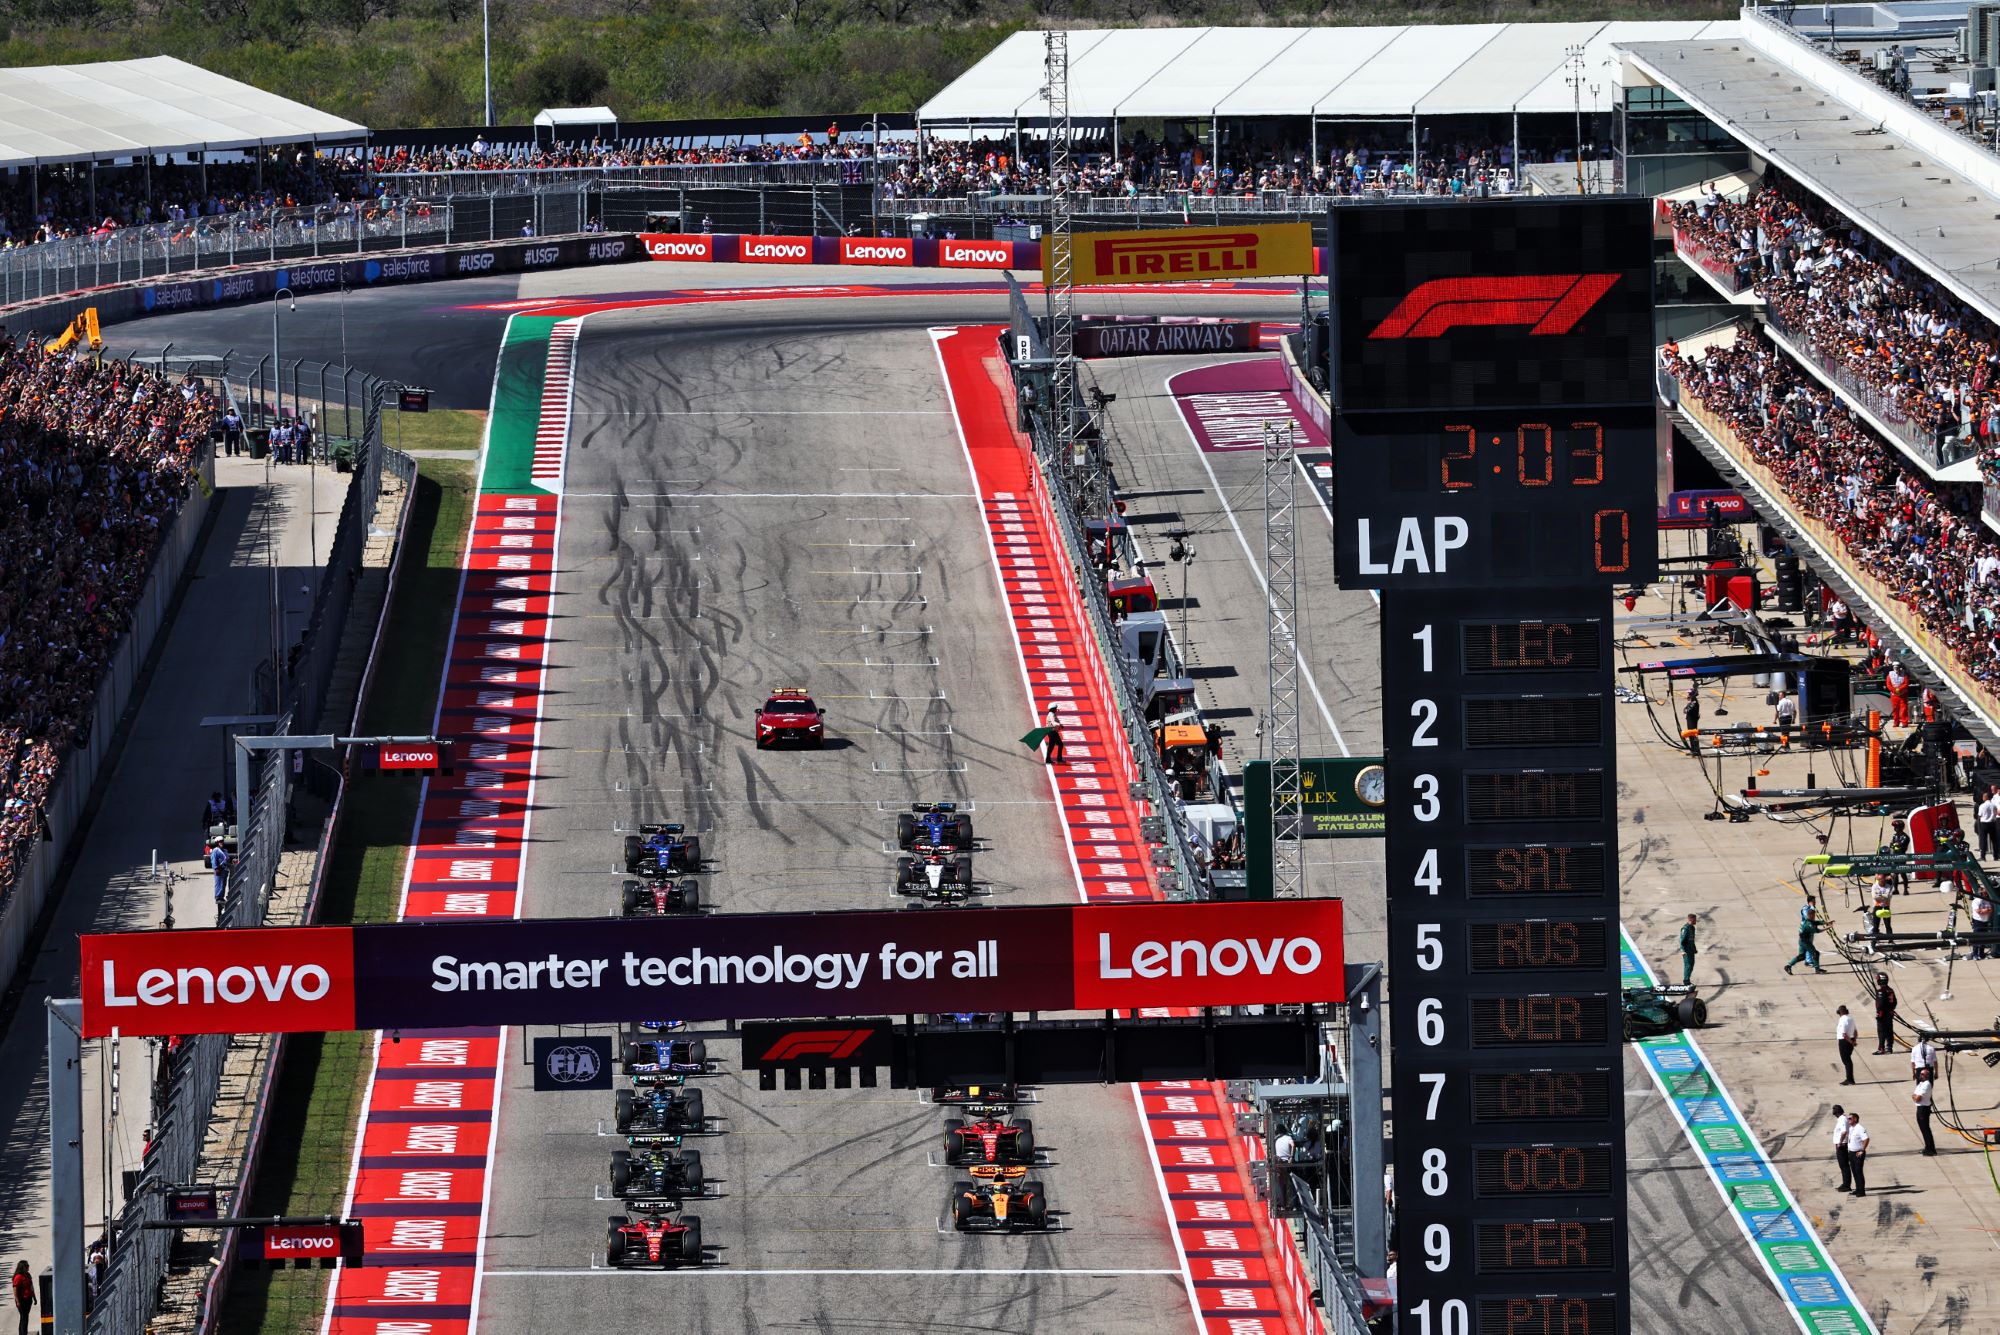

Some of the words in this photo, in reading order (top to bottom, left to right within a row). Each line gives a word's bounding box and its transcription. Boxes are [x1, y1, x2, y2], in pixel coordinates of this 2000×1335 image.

[459, 253, 494, 271] #USGP
[525, 247, 560, 265] #USGP
[589, 242, 625, 259] #USGP
[645, 240, 706, 256] Lenovo
[745, 241, 806, 257] Lenovo
[846, 243, 906, 260] Lenovo
[945, 245, 1007, 262] Lenovo
[1095, 233, 1259, 276] PIRELLI
[291, 266, 336, 289] salesforce
[383, 258, 430, 279] salesforce
[1101, 327, 1150, 353] QATAR
[1156, 324, 1234, 351] AIRWAYS
[1441, 422, 1603, 487] 2:03
[1701, 500, 1739, 509] Lnovo
[1358, 516, 1469, 575] LAP
[1594, 510, 1630, 573] 0
[1413, 624, 1432, 672] 1
[1490, 624, 1573, 667] LEC
[1410, 699, 1438, 747] 2
[385, 752, 433, 762] Lenovo
[1413, 773, 1440, 822] 3
[1317, 823, 1355, 831] STATES
[1414, 849, 1442, 895] 4
[1496, 848, 1572, 891] SAI
[1100, 932, 1322, 979] Lenovo
[1416, 923, 1443, 971] 5
[1498, 922, 1579, 965] RUS
[103, 960, 330, 1007] Lenovo
[431, 954, 609, 992] Smarter
[622, 945, 870, 990] technology
[879, 942, 943, 980] for
[951, 939, 998, 979] all
[1417, 997, 1445, 1046] 6
[1499, 997, 1581, 1040] VER
[1419, 1073, 1446, 1121] 7
[1421, 1148, 1449, 1196] 8
[1503, 1147, 1585, 1191] OCO
[179, 1200, 205, 1209] Lenovo
[270, 1235, 334, 1250] Lenovo
[1424, 1223, 1450, 1272] 9
[1504, 1222, 1588, 1266] PER
[1410, 1299, 1468, 1335] 10
